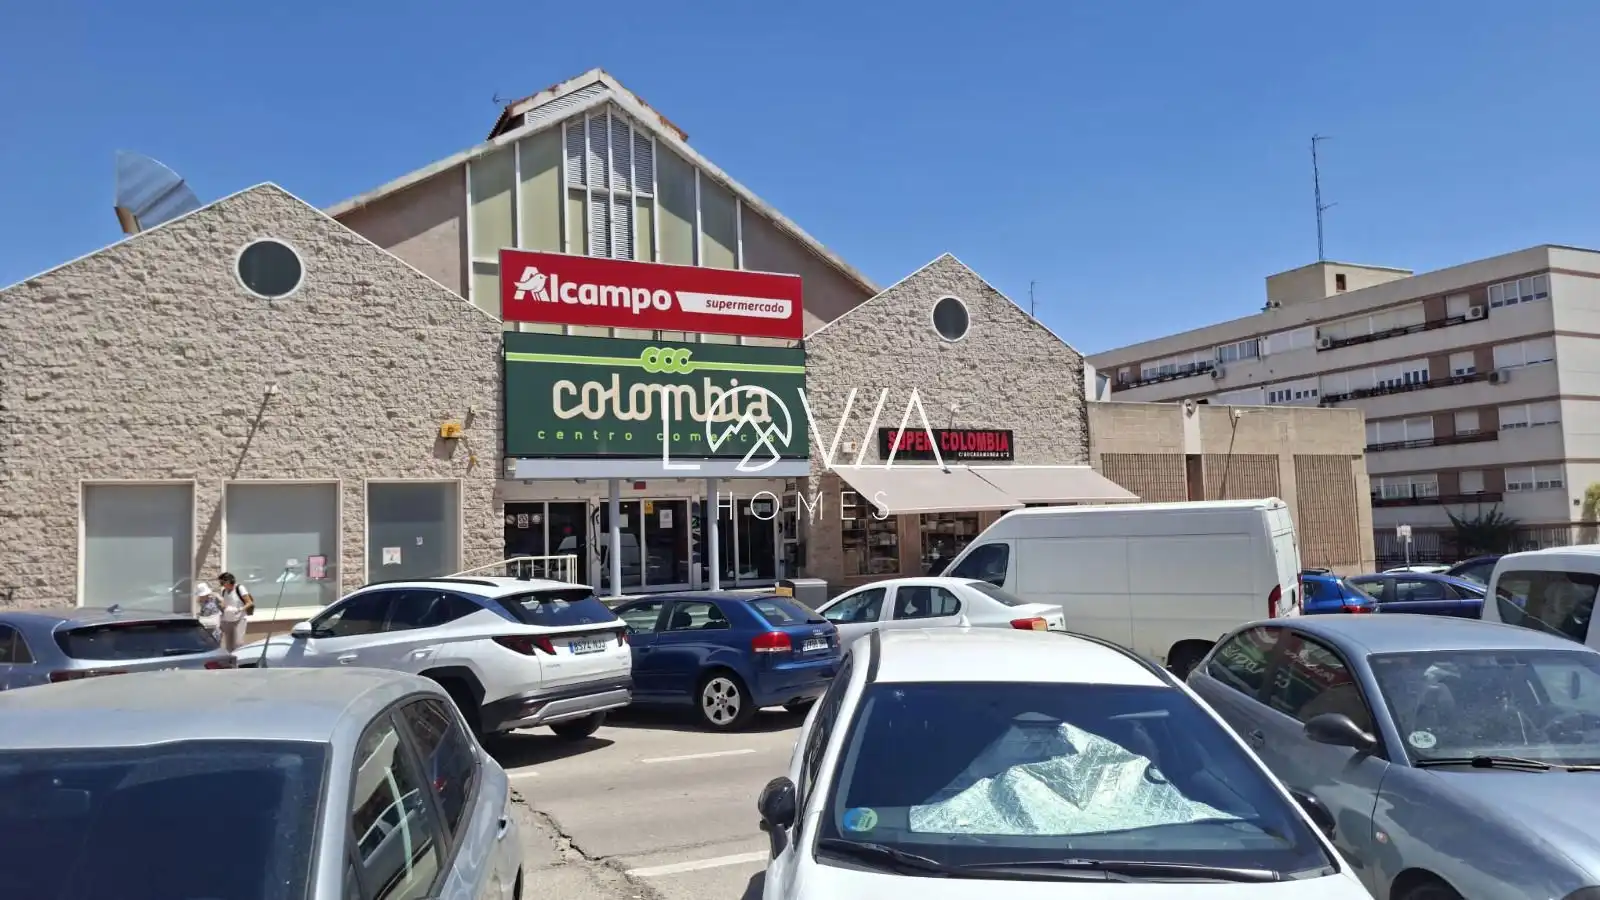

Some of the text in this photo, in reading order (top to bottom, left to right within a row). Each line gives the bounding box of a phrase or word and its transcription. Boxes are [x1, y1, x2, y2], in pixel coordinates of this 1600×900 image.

[514, 266, 784, 314] Alcampo supermercado
[552, 373, 771, 423] colombia
[537, 429, 788, 443] centro comercia
[887, 431, 1008, 451] SUPER COLOMBIA
